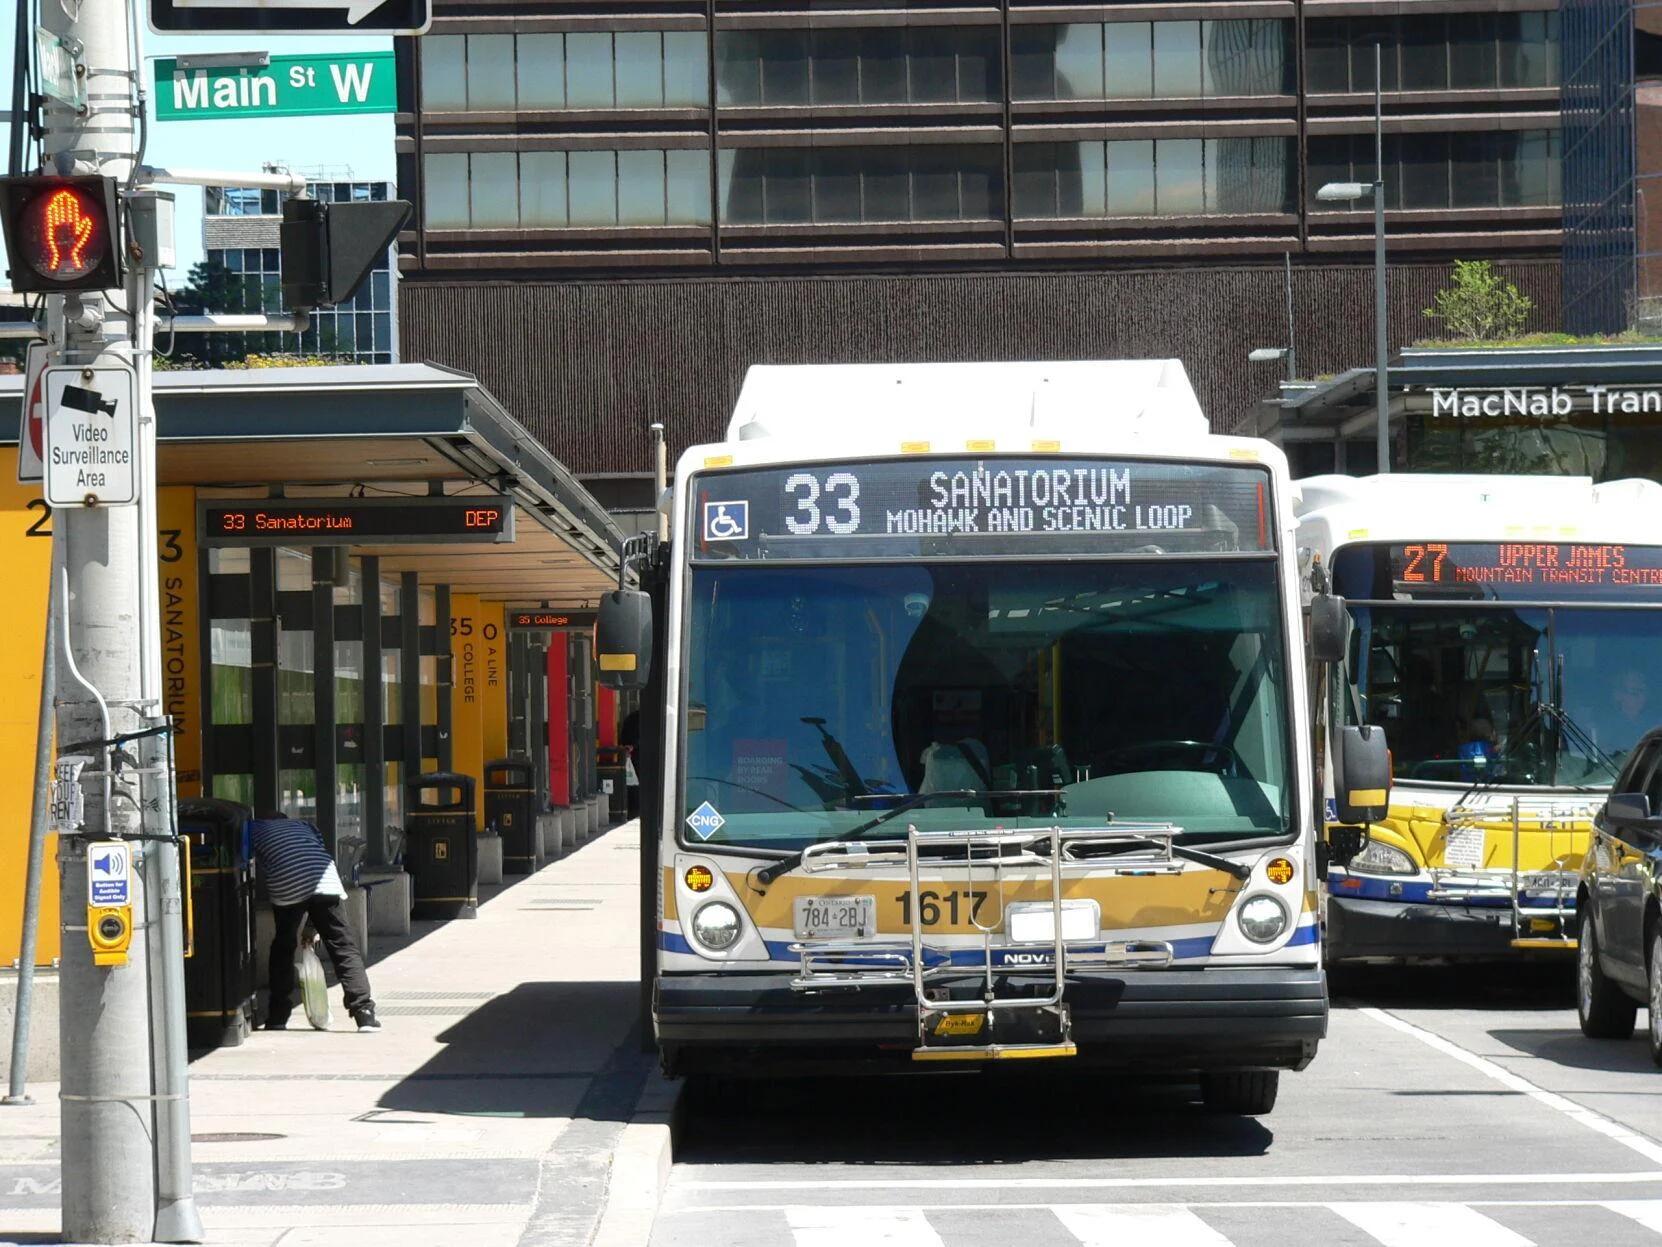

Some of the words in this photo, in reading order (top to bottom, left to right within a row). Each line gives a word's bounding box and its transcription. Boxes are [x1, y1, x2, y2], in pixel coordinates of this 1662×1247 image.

[173, 69, 277, 110] Main
[289, 65, 316, 88] St
[330, 63, 374, 103] W
[1433, 387, 1572, 417] MacNab
[1586, 385, 1662, 414] Tran
[72, 424, 108, 442] Video
[53, 446, 129, 465] Surveillance
[77, 469, 105, 487] Area
[930, 468, 1130, 508] SANATORIUM
[784, 473, 860, 535] 33
[223, 514, 245, 530] 33
[256, 513, 352, 530] Sanatorium
[465, 510, 498, 527] DEP
[887, 508, 978, 533] MOHAWK
[987, 508, 1033, 531] AND
[1042, 506, 1126, 531] SCENIC
[1135, 505, 1192, 529] LOOP
[1404, 544, 1447, 582] 27
[1500, 544, 1558, 567] UPPER
[1565, 545, 1625, 567] JAMES
[1456, 567, 1533, 583] MOUNTAIN
[1541, 568, 1604, 583] TRANSIT
[518, 616, 530, 624] 35
[534, 615, 568, 626] College
[165, 577, 186, 735] SANATORIUM
[488, 647, 496, 655] A
[463, 643, 475, 703] COLLEGE
[488, 660, 497, 686] LINE
[691, 816, 719, 827] CNG
[895, 891, 988, 925] 1617
